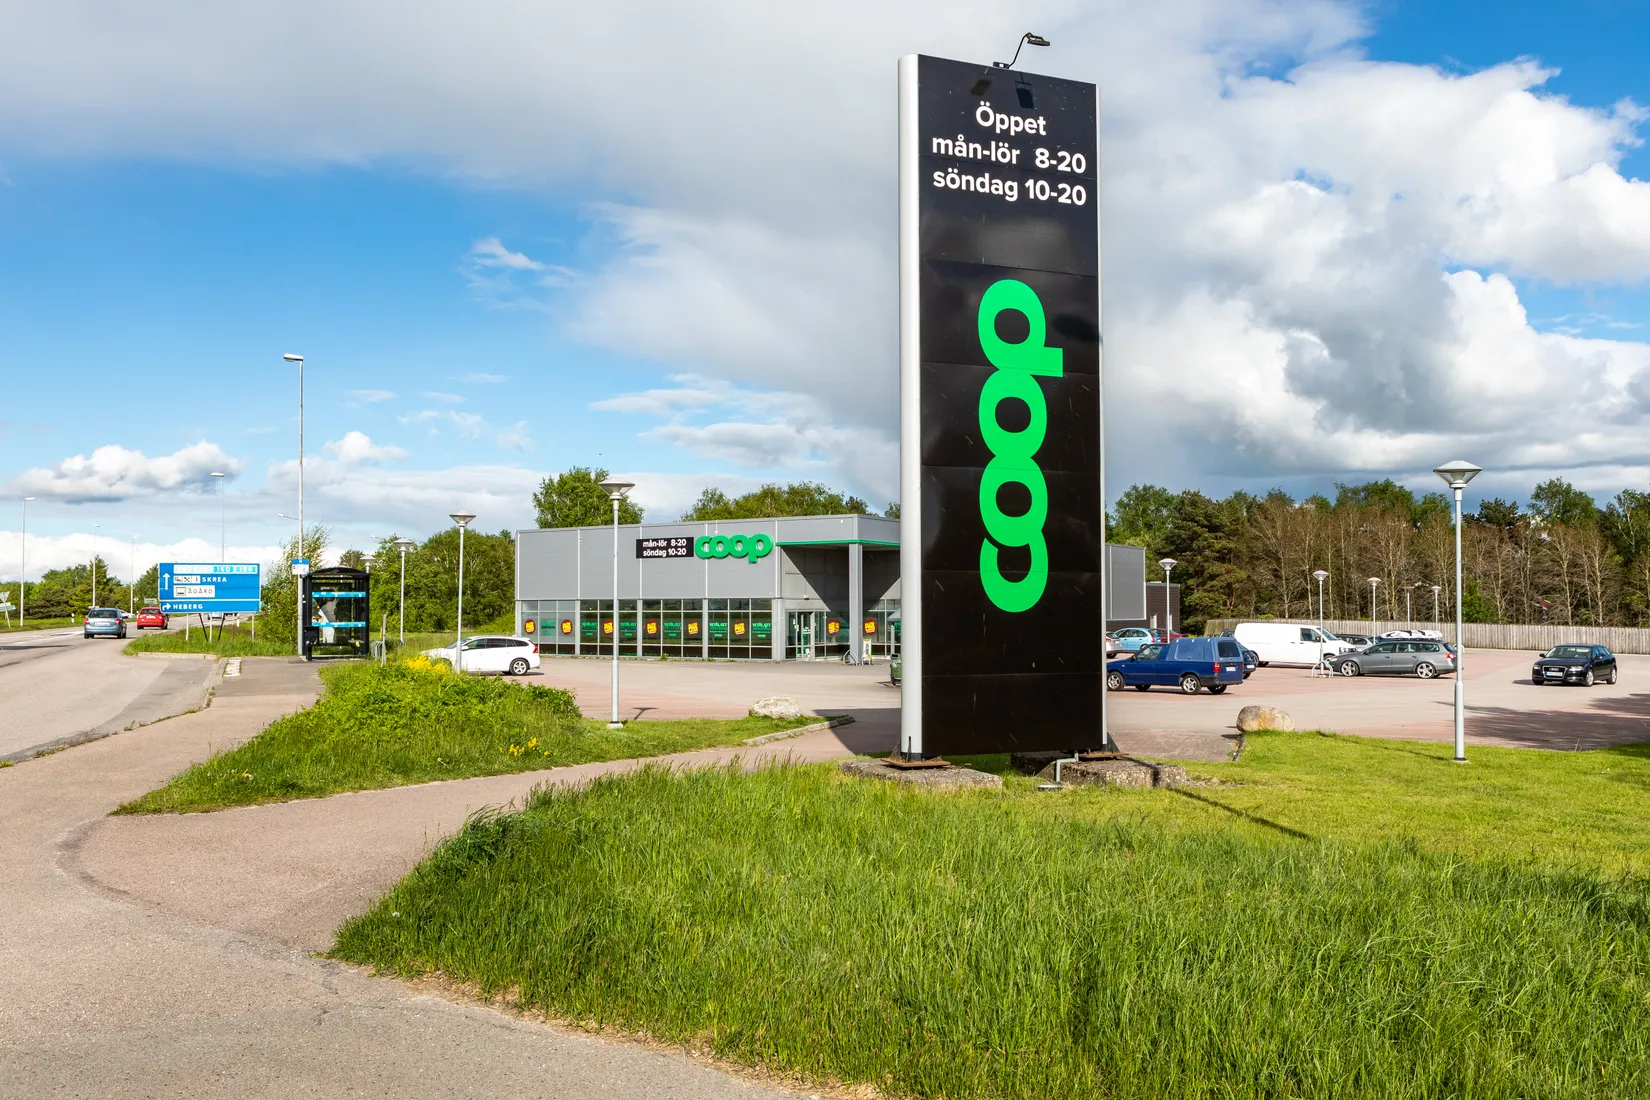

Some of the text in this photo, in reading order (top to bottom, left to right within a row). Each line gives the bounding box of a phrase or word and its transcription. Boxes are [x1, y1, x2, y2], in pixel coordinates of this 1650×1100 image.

[975, 101, 1047, 136] Öppet
[932, 134, 1087, 174] mån-lör 8-20
[932, 168, 1087, 206] söndag 10-20
[978, 279, 1063, 613] coop
[642, 538, 687, 548] mån-lör 8-20
[642, 547, 687, 558] söndag 10-20
[694, 533, 773, 564] coop
[187, 587, 213, 595] ÅGÅRD
